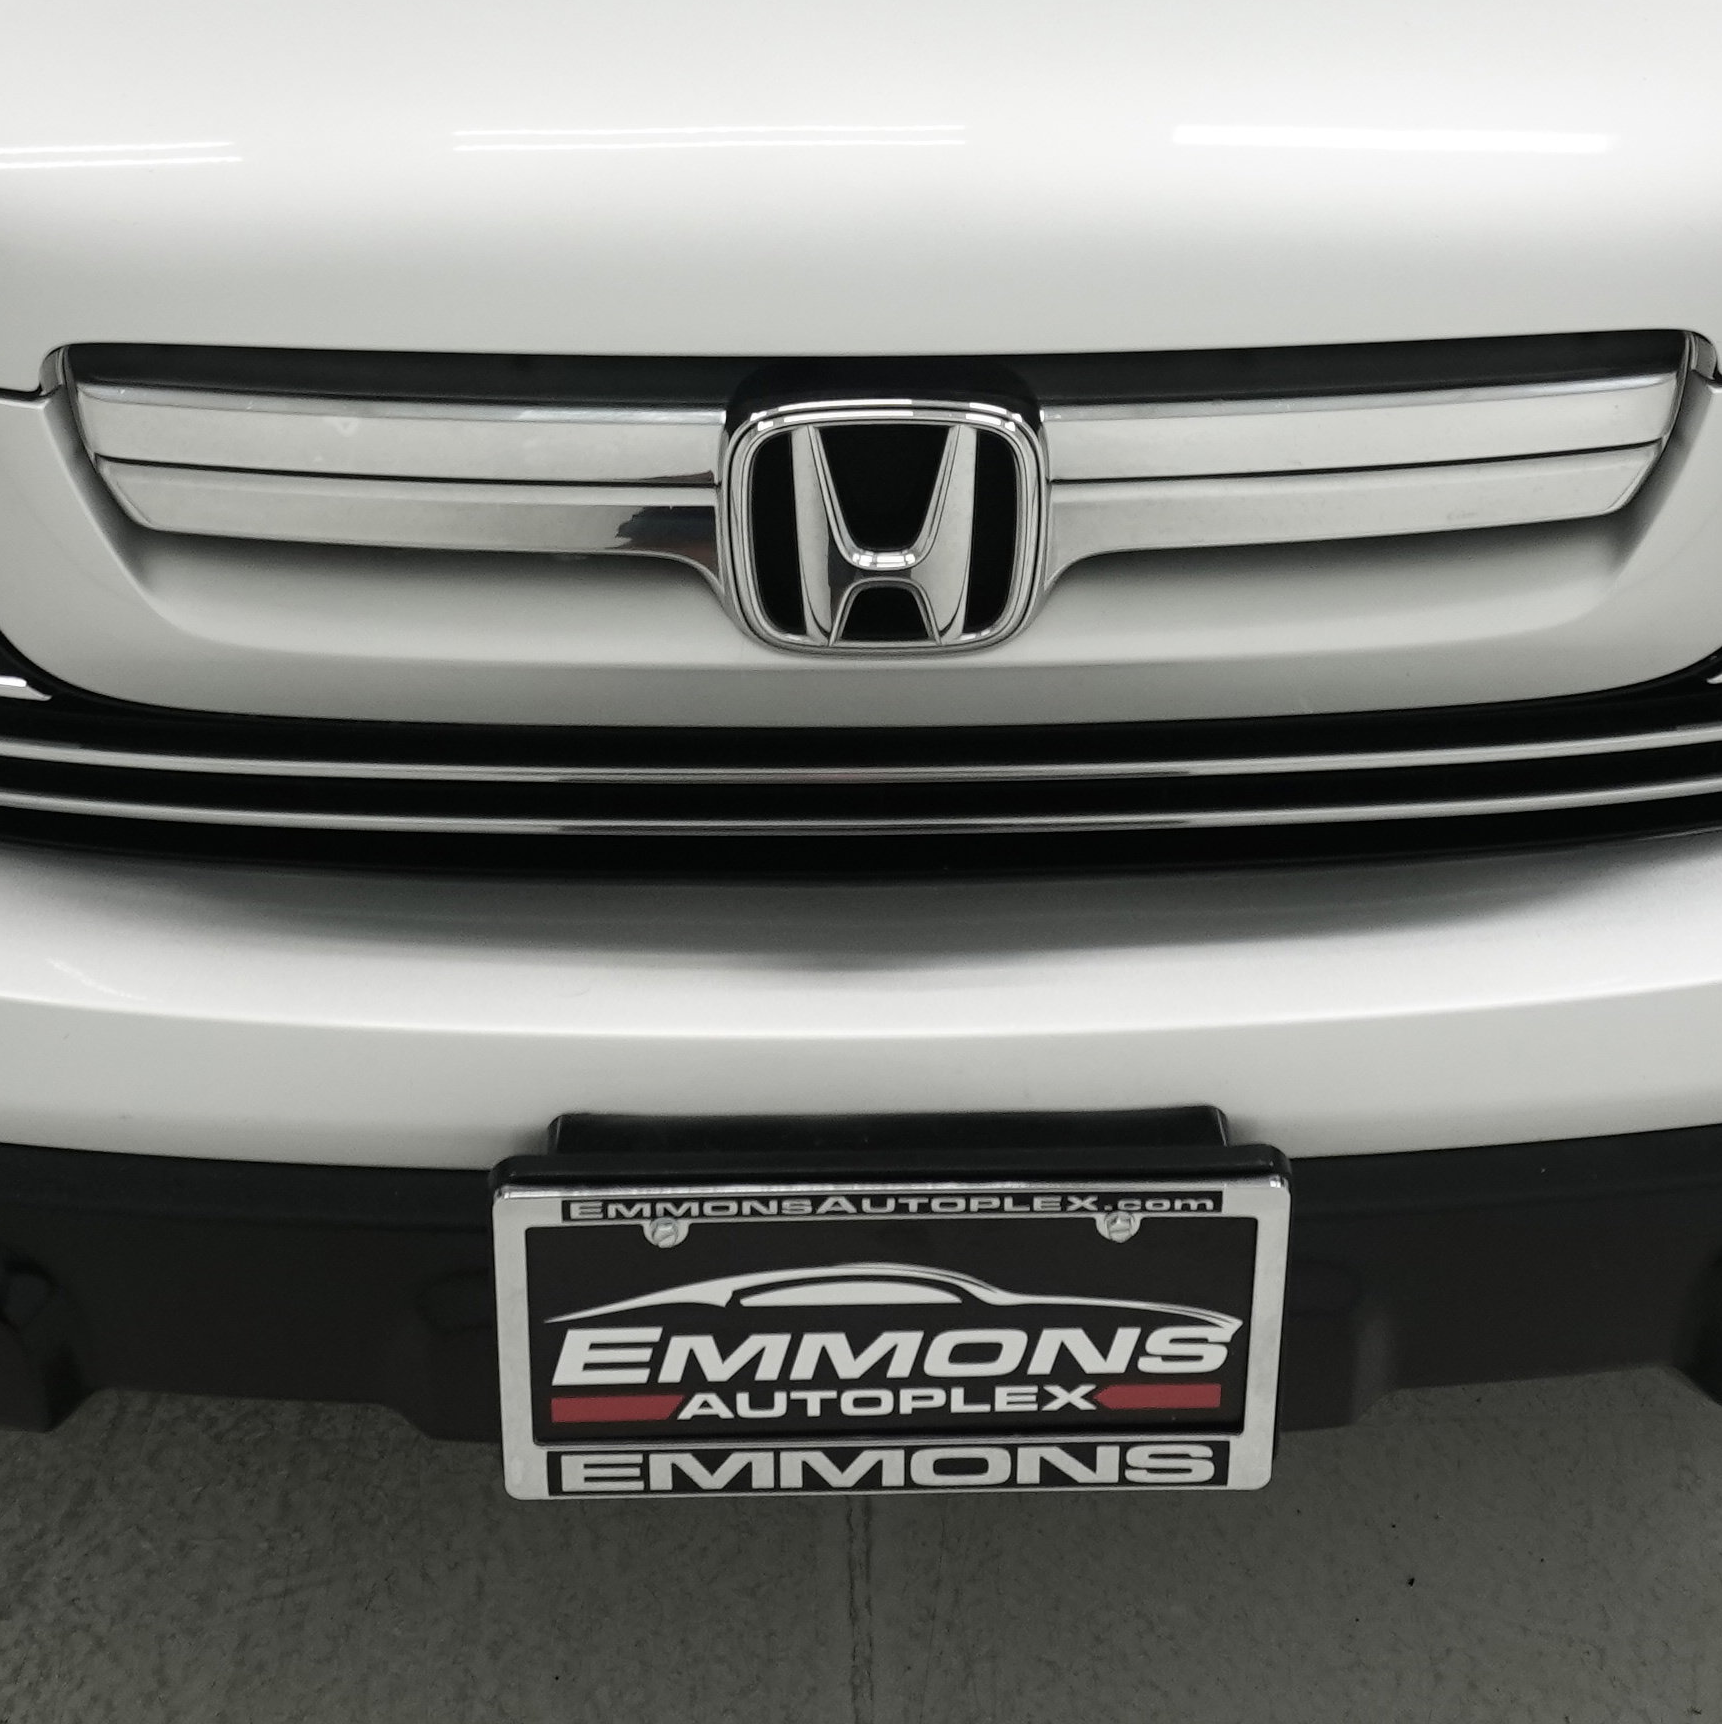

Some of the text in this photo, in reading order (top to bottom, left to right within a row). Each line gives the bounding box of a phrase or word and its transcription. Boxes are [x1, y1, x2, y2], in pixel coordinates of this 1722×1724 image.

[551, 1326, 1231, 1386] EMMONS
[677, 1385, 1098, 1420] AUTOPLEX
[561, 1445, 1215, 1492] EMMONS
